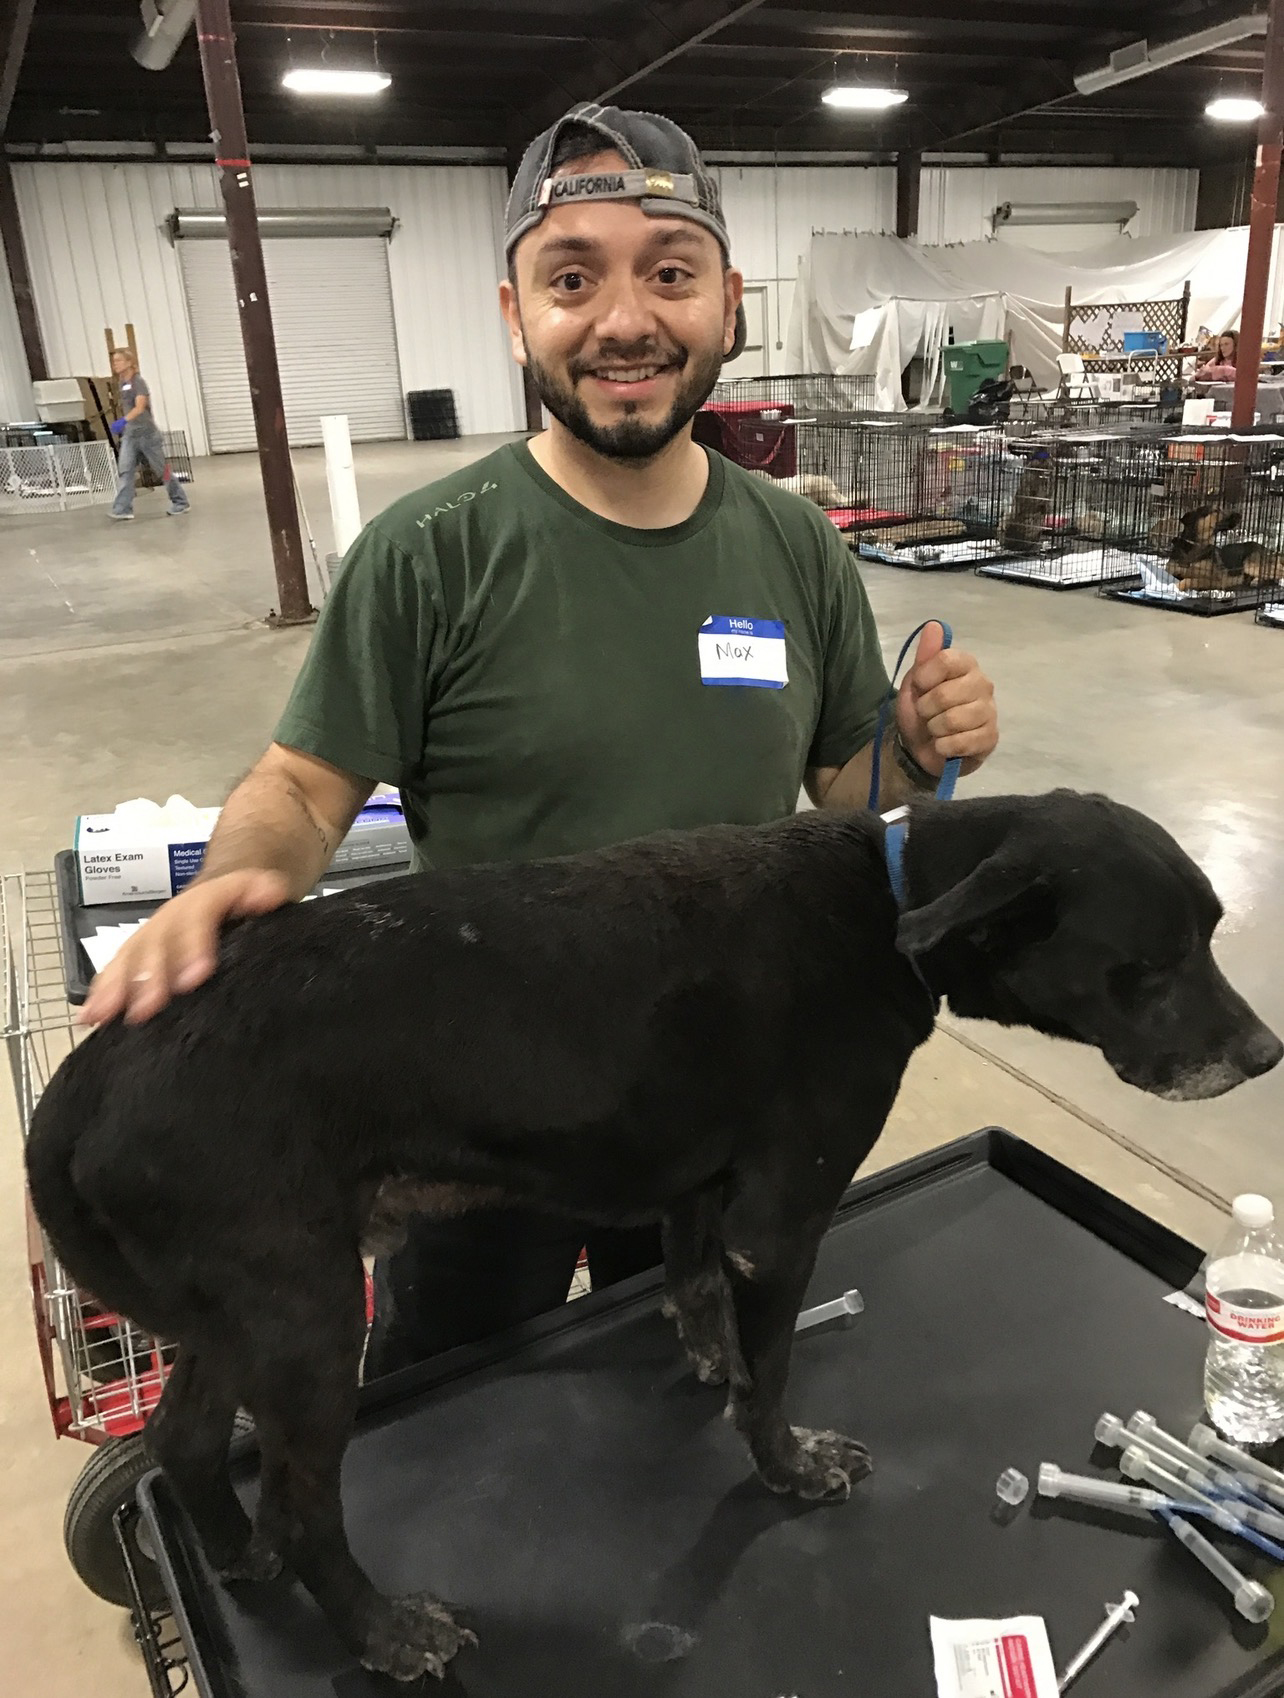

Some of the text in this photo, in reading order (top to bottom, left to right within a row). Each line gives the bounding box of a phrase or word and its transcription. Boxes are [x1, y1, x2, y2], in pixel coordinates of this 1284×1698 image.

[554, 176, 626, 198] CALIFORNIA
[415, 491, 476, 528] HALO
[729, 618, 754, 630] Hello
[716, 642, 754, 661] Max
[83, 853, 144, 863] Latex Exam
[173, 848, 202, 857] Medical
[84, 865, 121, 874] Gloves
[1230, 1313, 1281, 1324] DRINKING
[1237, 1320, 1275, 1329] WATER
